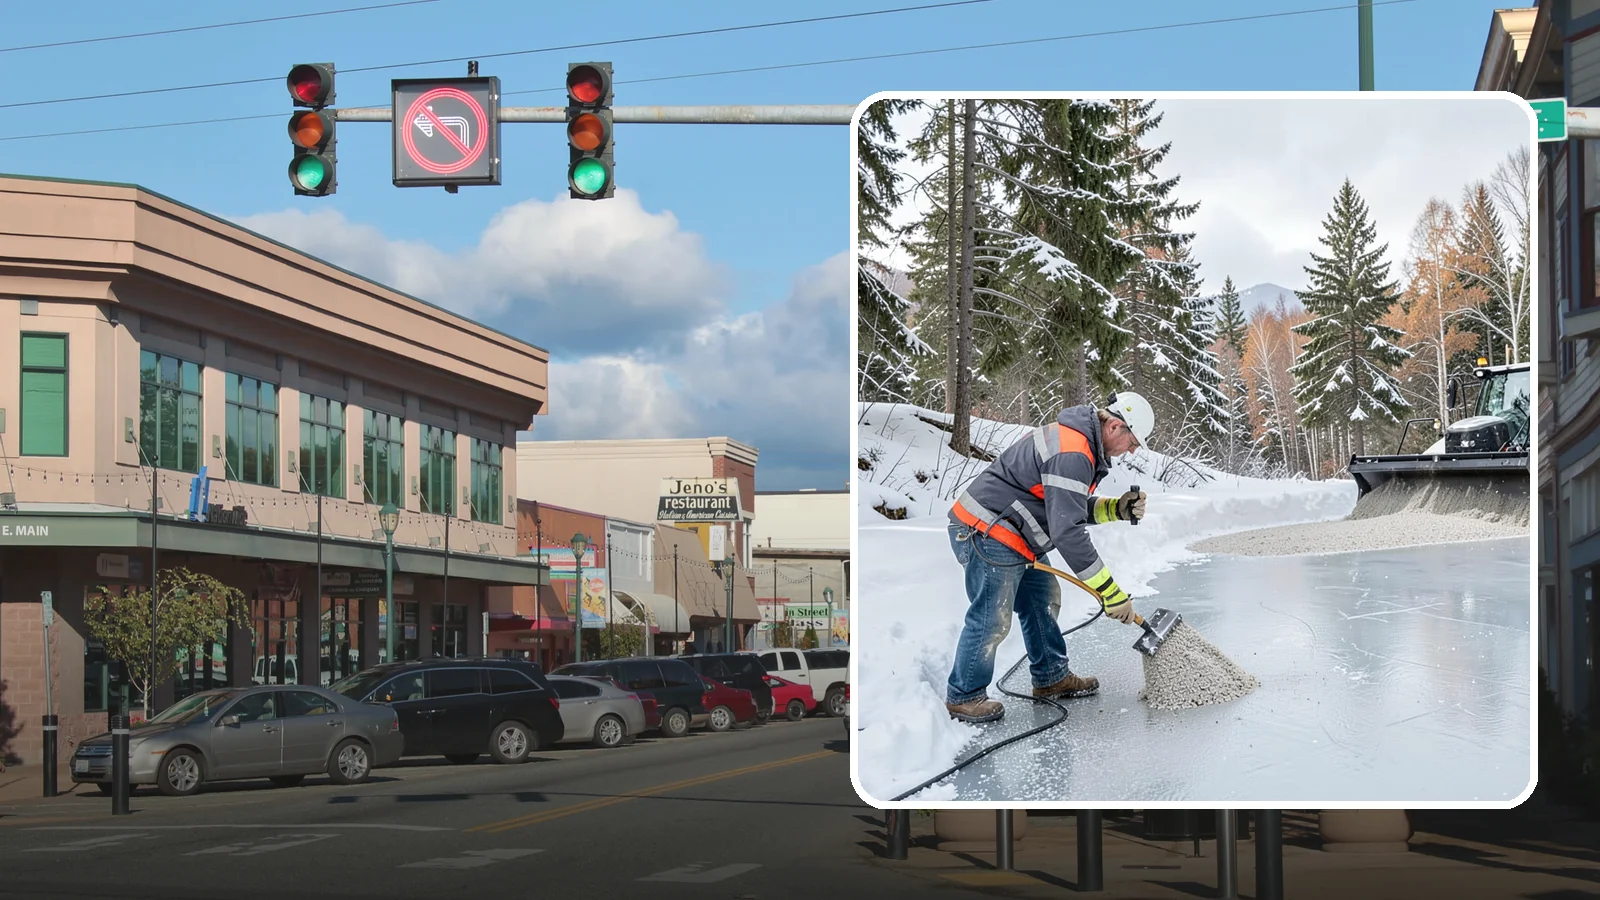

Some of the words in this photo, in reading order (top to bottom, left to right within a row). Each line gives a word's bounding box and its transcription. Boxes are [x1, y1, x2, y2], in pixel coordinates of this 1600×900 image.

[669, 480, 728, 494] Jeno's
[665, 497, 731, 509] restaurant
[658, 510, 681, 520] Italian
[686, 510, 714, 519] American
[715, 510, 738, 519] Cuisine
[2, 525, 13, 536] E.
[16, 525, 49, 536] MAIN
[786, 608, 795, 617] in
[797, 608, 829, 617] Street
